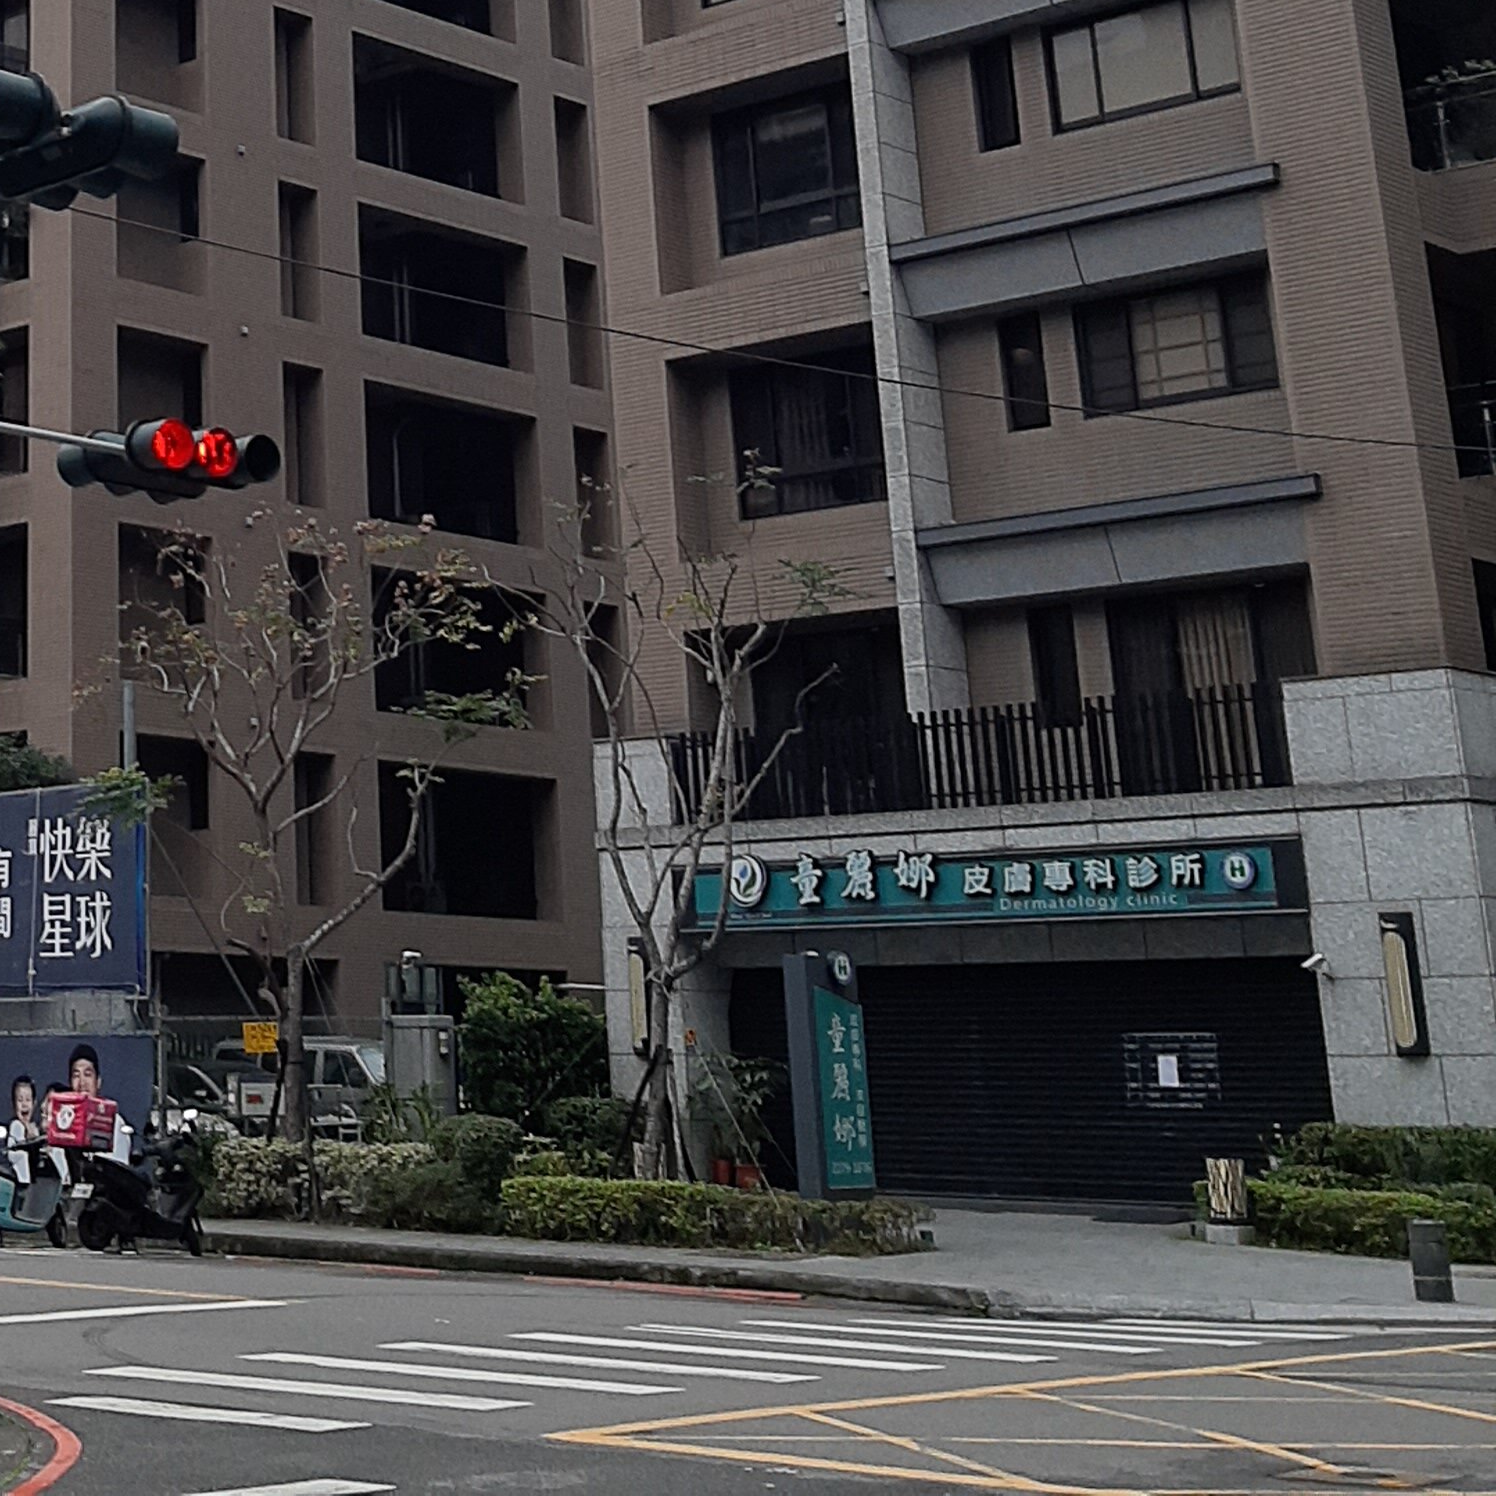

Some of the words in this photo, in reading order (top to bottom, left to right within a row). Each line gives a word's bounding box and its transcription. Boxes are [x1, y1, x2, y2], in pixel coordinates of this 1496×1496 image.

[40, 817, 112, 883] 快樂
[963, 853, 1203, 895] 皮膚專科診所
[39, 891, 112, 958] 星球
[999, 894, 1118, 911] Dermatology
[1125, 891, 1178, 906] clinic
